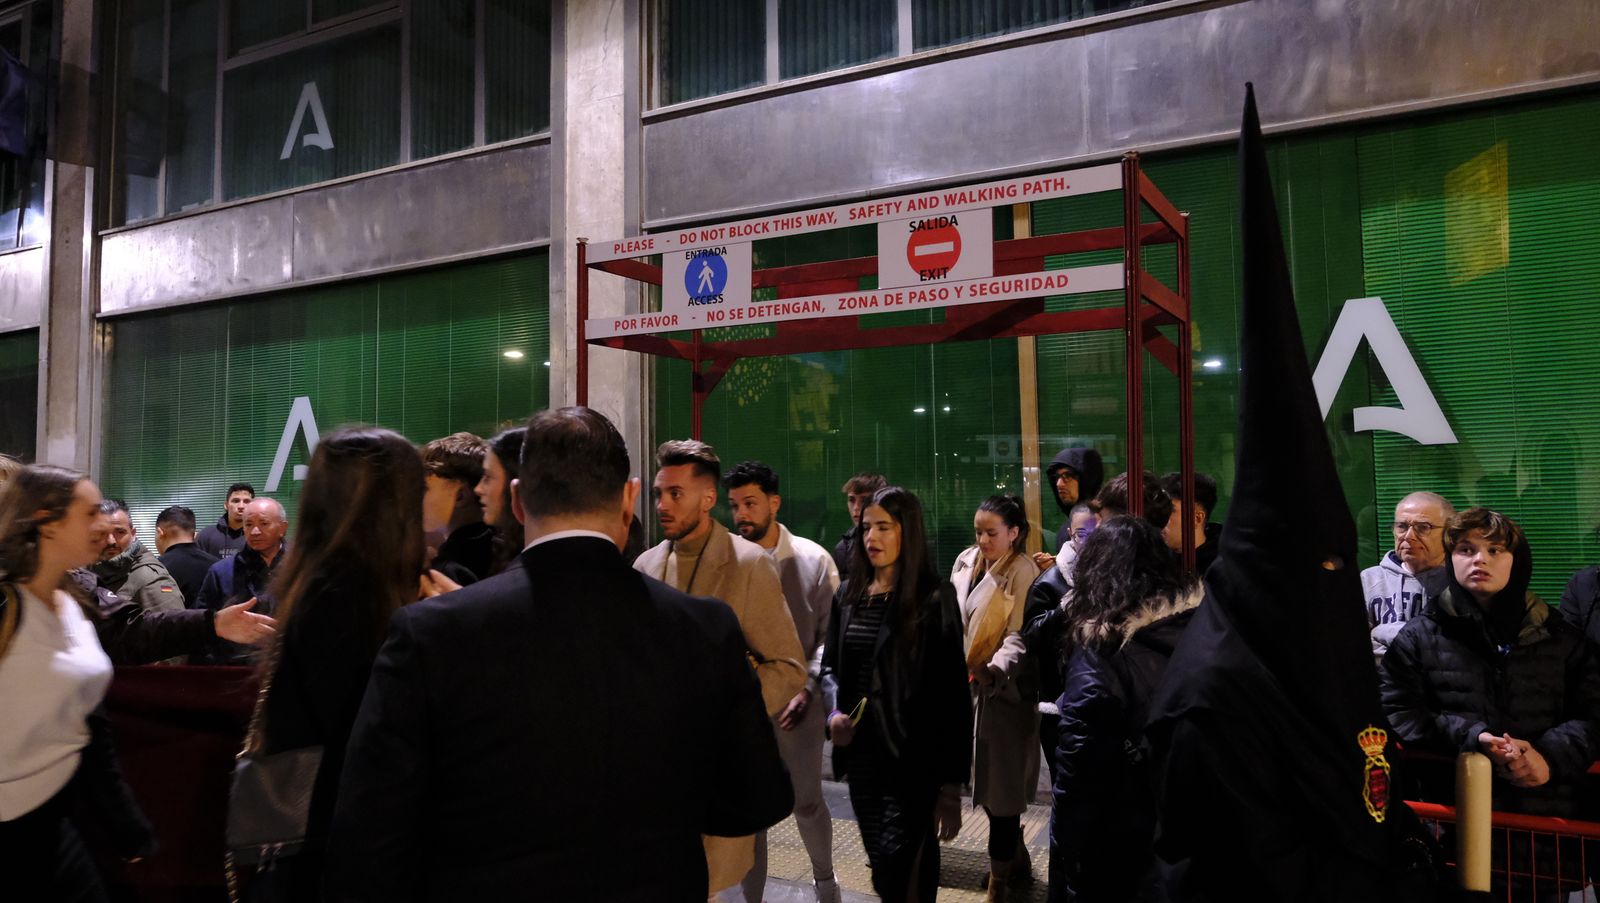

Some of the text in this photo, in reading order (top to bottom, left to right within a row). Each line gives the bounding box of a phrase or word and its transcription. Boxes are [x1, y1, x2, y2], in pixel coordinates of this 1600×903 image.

[614, 240, 654, 253] PLEASE
[680, 232, 697, 244] DO
[700, 228, 725, 242] NOT
[729, 222, 769, 238] BLOCK
[773, 216, 802, 231] THIS
[806, 211, 838, 227] WAY,
[849, 202, 902, 221] SAFETY
[908, 195, 940, 211] AND
[944, 184, 1017, 206] WALKING
[1023, 177, 1070, 197] PATH.
[909, 215, 958, 232] SALIDA
[686, 247, 727, 259] ENTRADA
[920, 267, 949, 281] EXIT
[614, 319, 637, 331] POR
[640, 314, 679, 328] FAVOR
[707, 310, 726, 321] NO
[729, 308, 743, 320] SE
[748, 301, 826, 318] DETENGAN,
[838, 295, 880, 311] ZONA
[884, 291, 903, 306] DE
[908, 287, 950, 304] PASO
[954, 286, 964, 298] Y
[969, 274, 1069, 298] SEGURIDAD
[688, 294, 723, 306] ACCESS
